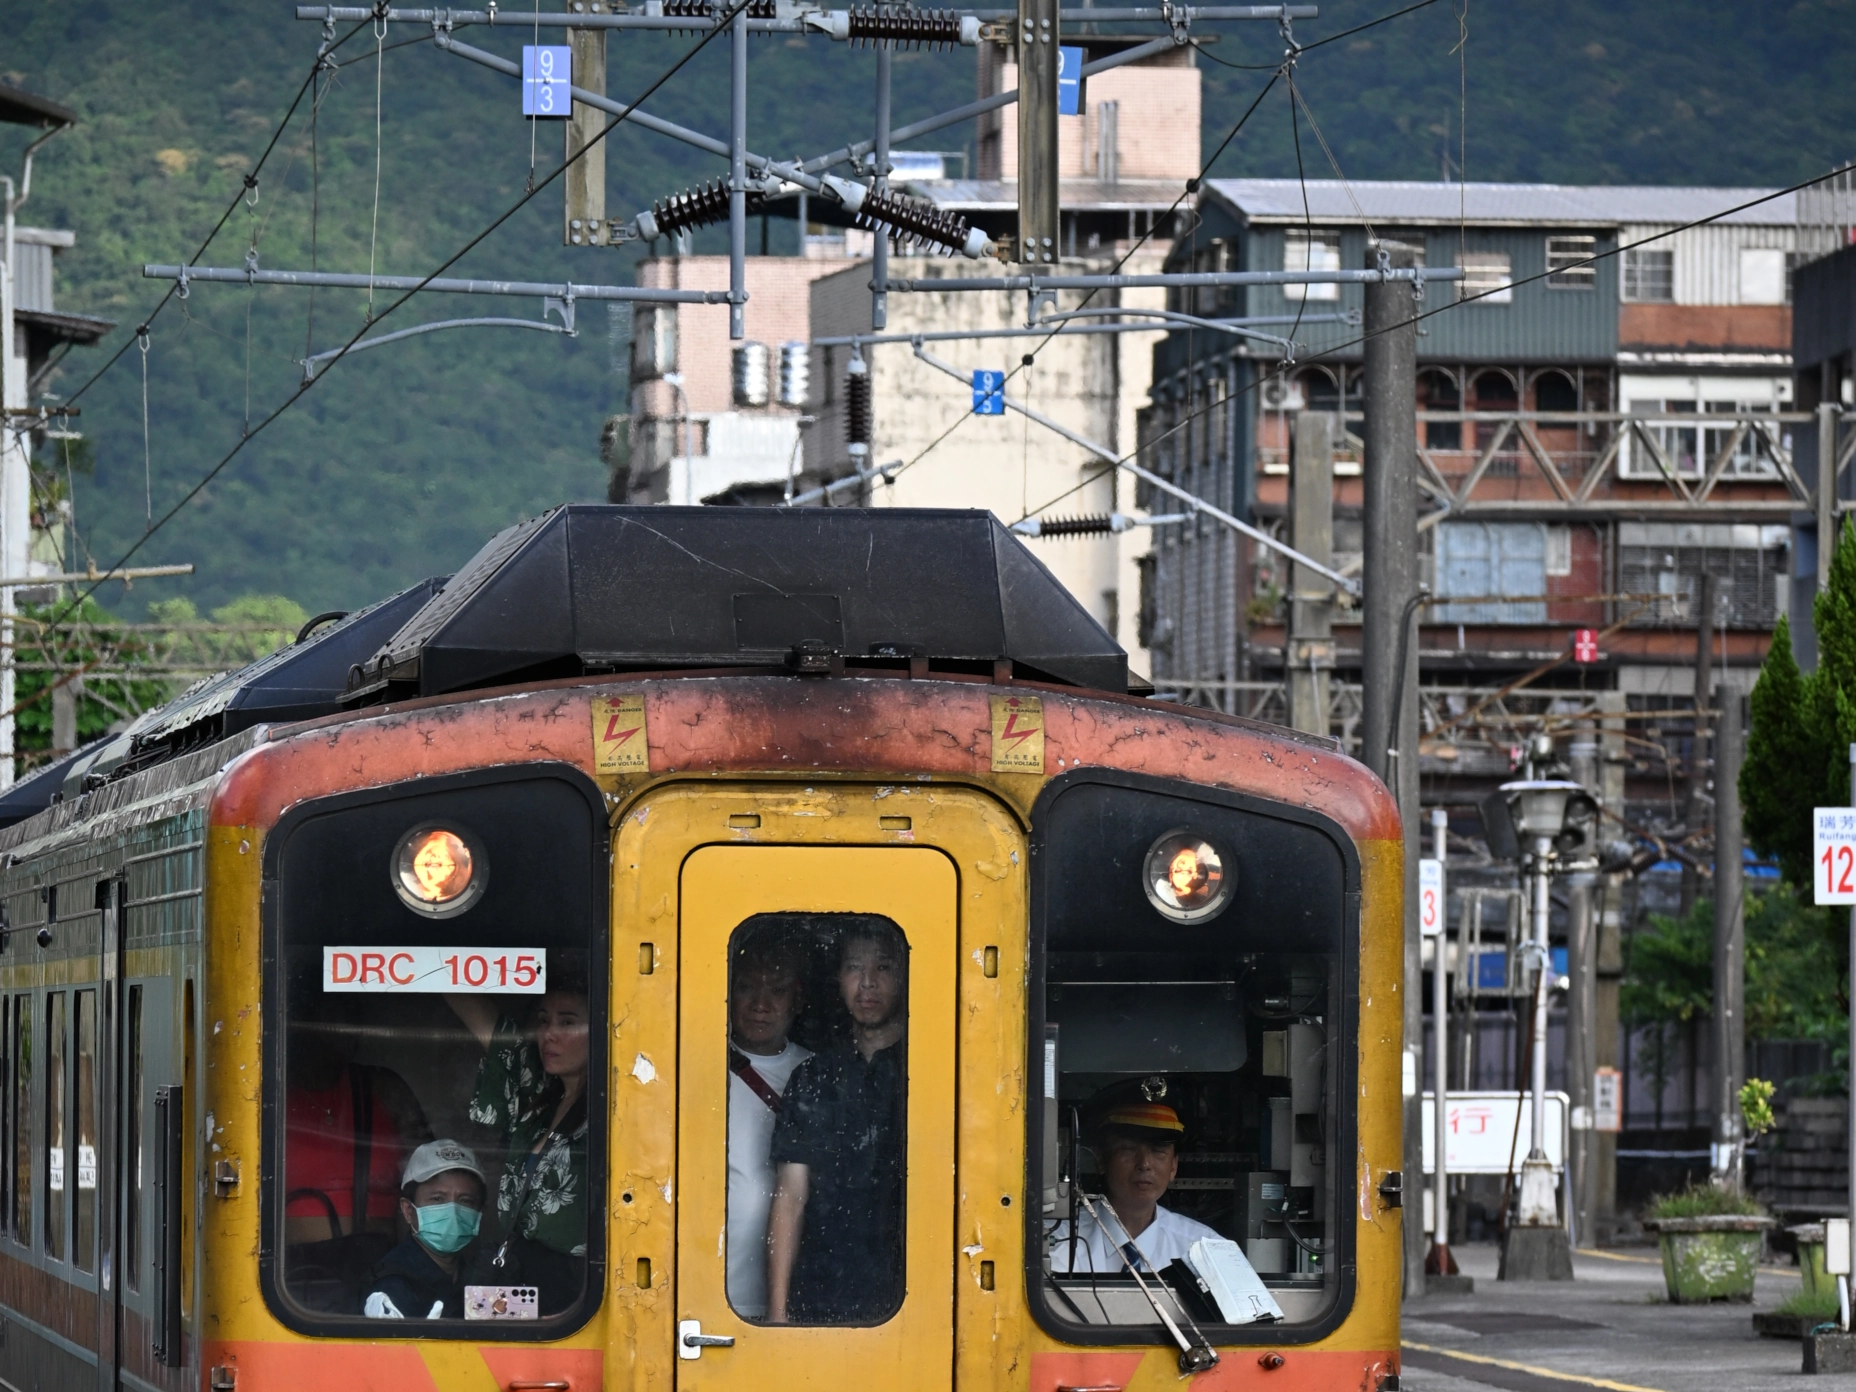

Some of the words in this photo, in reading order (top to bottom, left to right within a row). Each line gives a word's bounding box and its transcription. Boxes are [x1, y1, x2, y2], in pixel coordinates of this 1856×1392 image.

[540, 50, 553, 76] 9
[540, 86, 553, 112] 3
[983, 372, 994, 391] 9
[1820, 816, 1854, 830] 瑞芳
[1820, 832, 1856, 842] Ruifang
[1821, 845, 1854, 894] 12
[1423, 889, 1436, 927] 3
[331, 952, 416, 984] DRC
[444, 955, 538, 987] 1015
